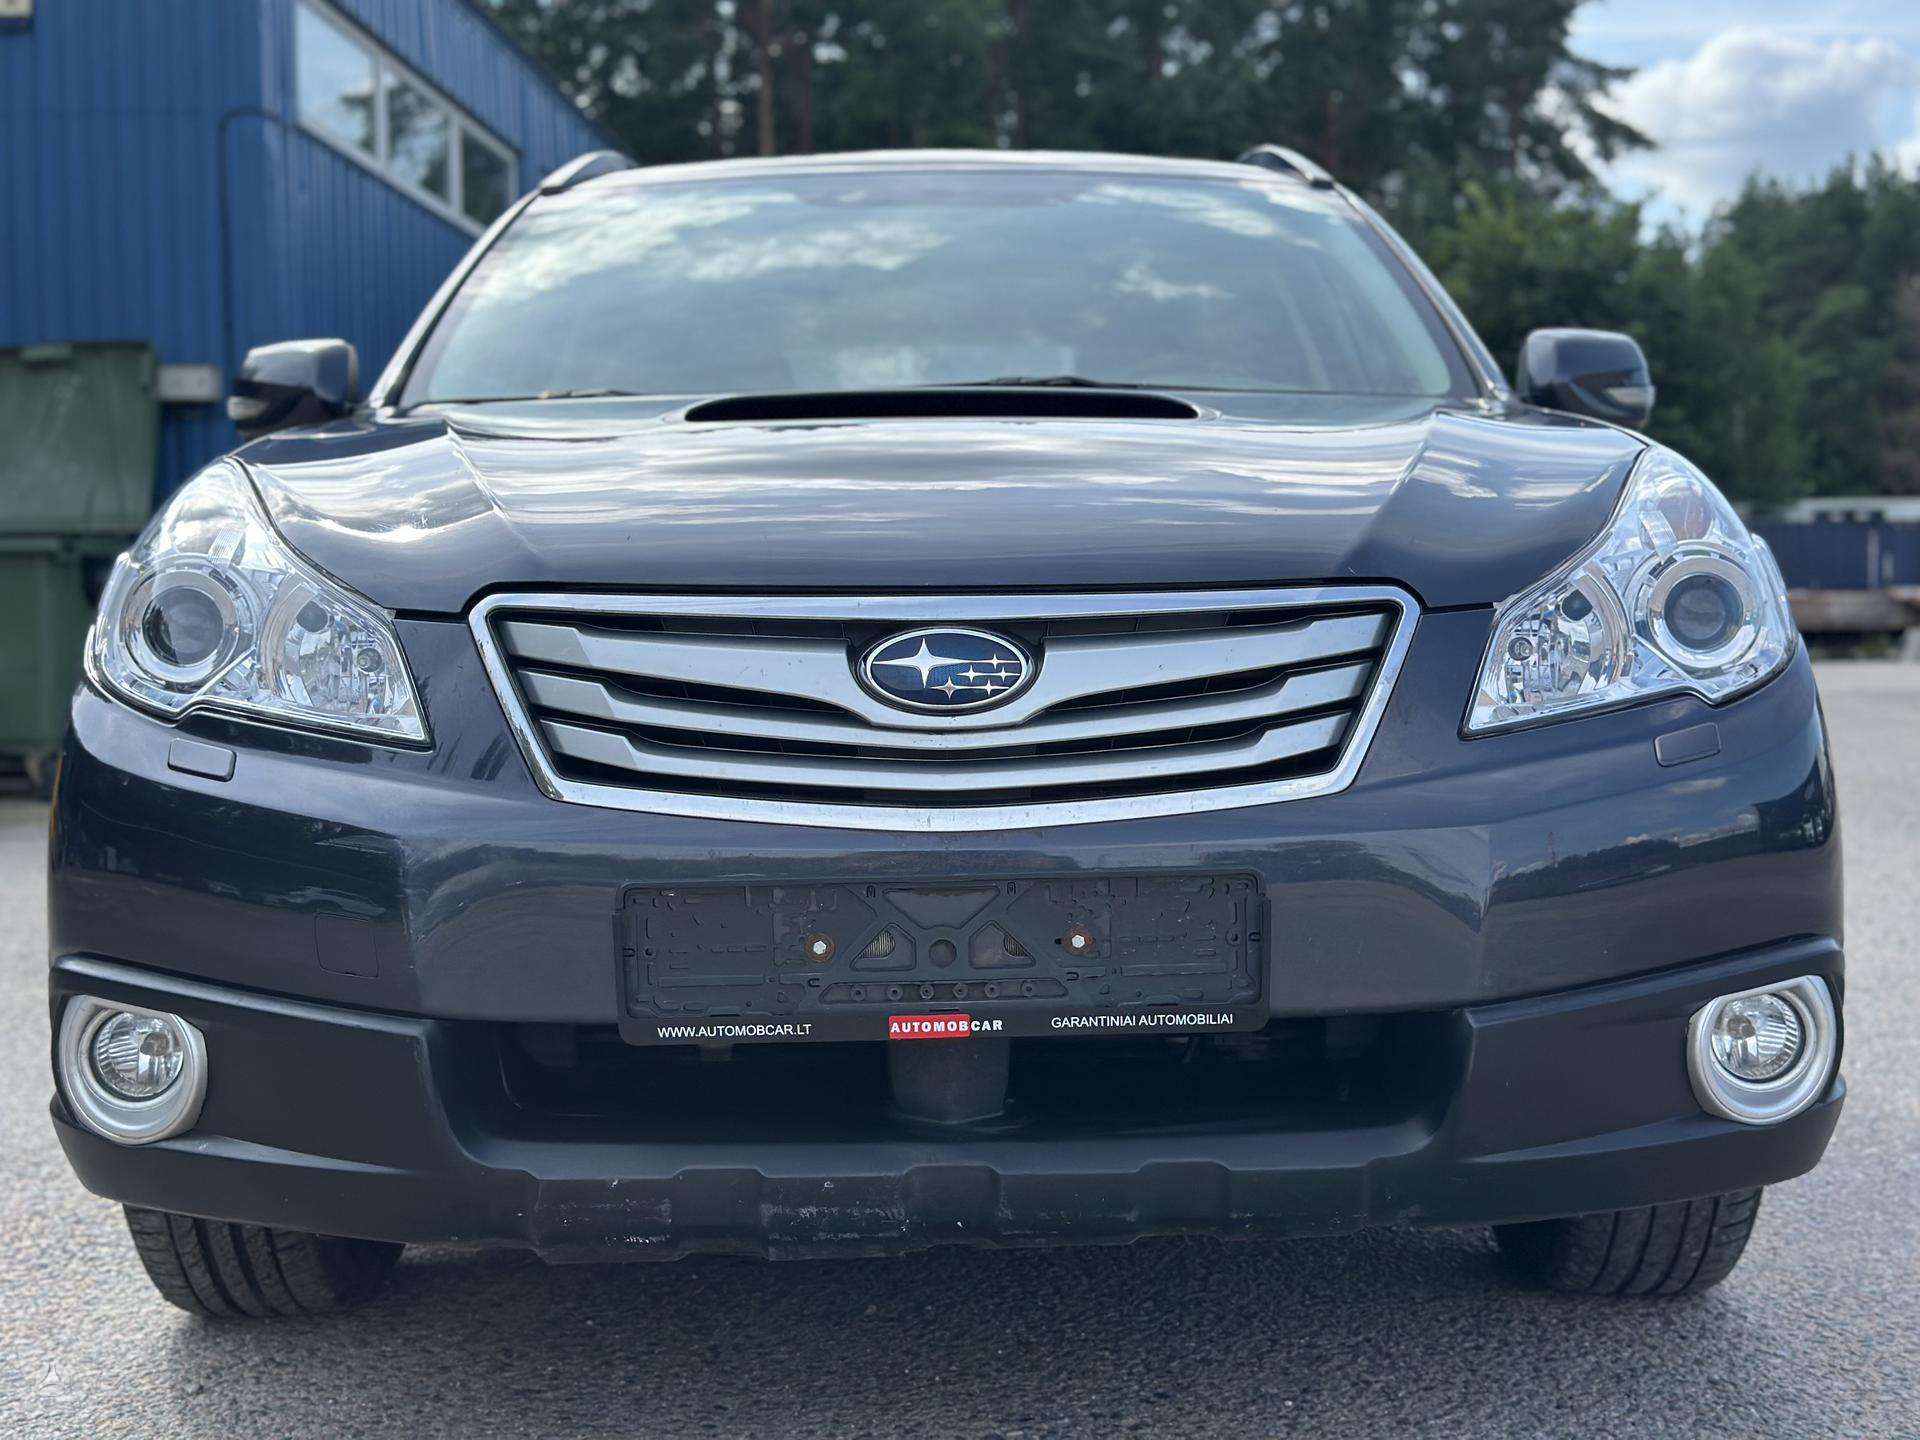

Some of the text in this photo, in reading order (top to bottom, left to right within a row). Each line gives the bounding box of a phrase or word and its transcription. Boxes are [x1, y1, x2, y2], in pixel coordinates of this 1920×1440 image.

[890, 1019, 1003, 1033] AUTOMOBCAR
[1051, 1013, 1233, 1029] GARANTINIAI AUTOMOBILIAI
[657, 1023, 812, 1038] WWW.AUTOMOBCAR.LT
